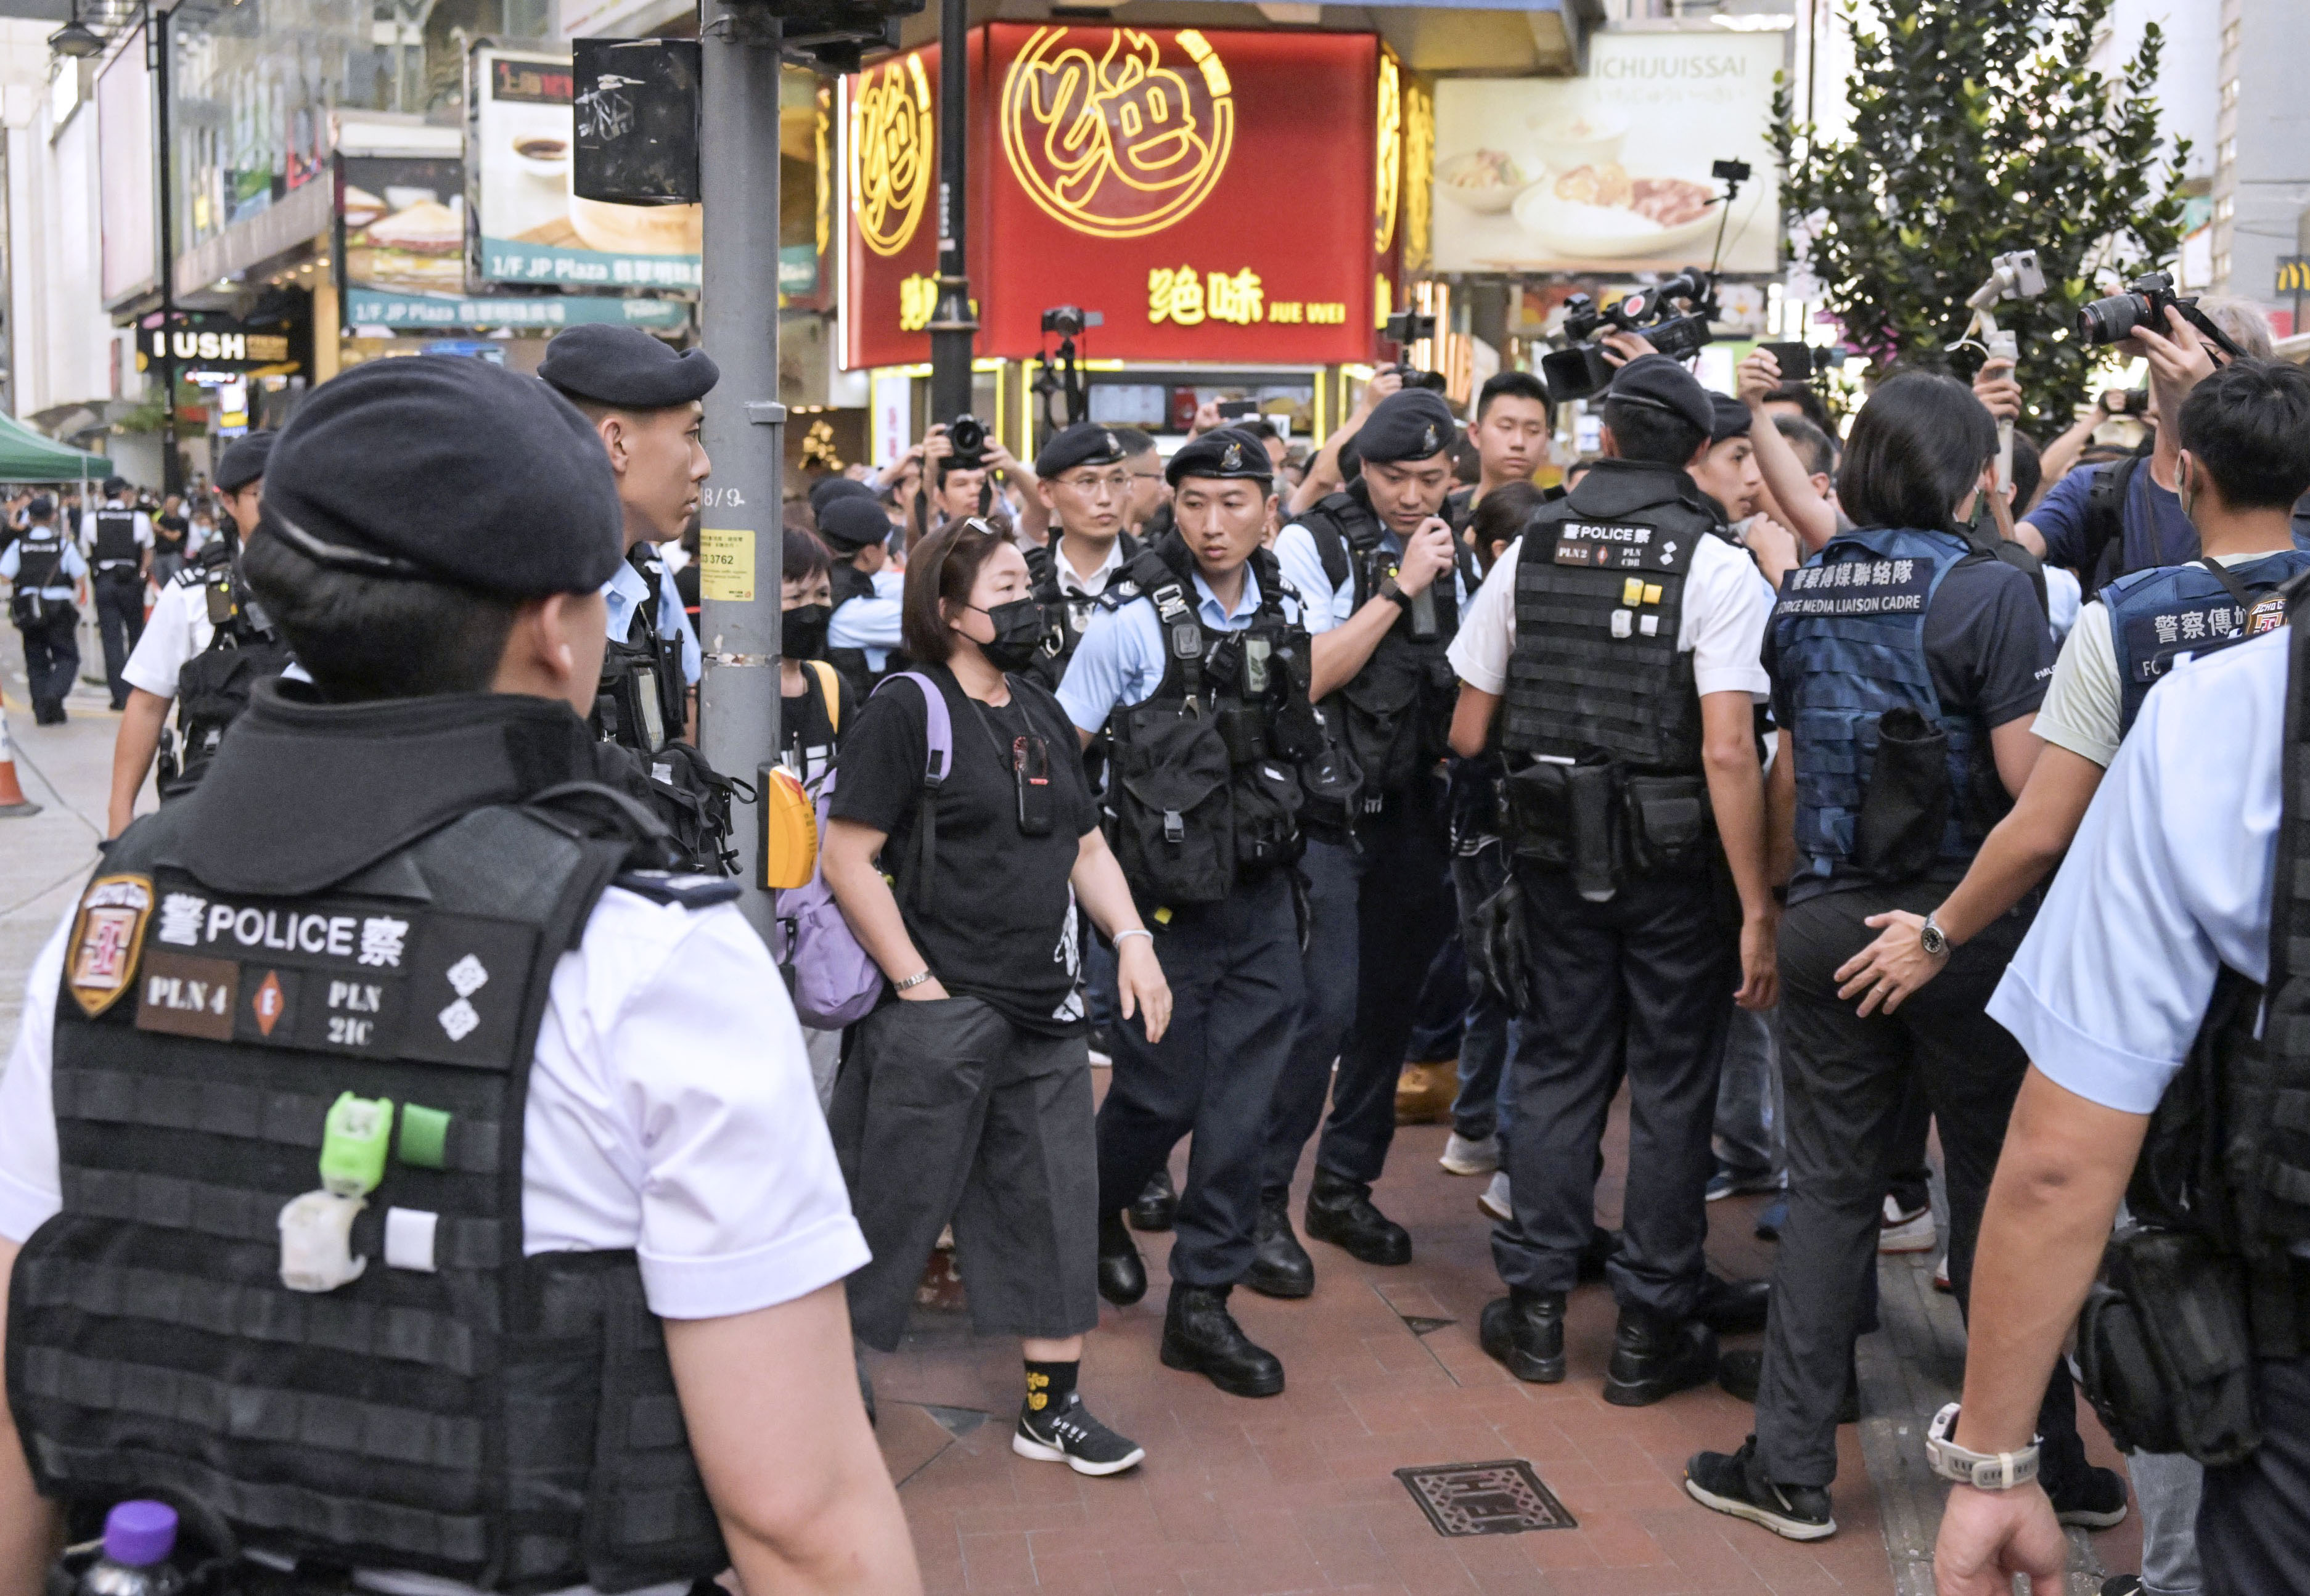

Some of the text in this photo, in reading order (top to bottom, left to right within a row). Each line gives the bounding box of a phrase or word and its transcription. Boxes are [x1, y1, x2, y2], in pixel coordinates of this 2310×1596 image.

[492, 255, 524, 277] 1/F
[526, 256, 554, 279] JP
[555, 256, 608, 282] Plaza
[710, 555, 734, 565] 3762
[1792, 560, 1914, 591] 警察傳媒聯絡隊
[1776, 595, 1922, 615] FORCE MEDIA LIAISON CADRE
[2251, 602, 2276, 615] ECHO
[147, 975, 227, 1015] PLN 4
[261, 988, 276, 1016] E
[327, 980, 382, 1013] PLN
